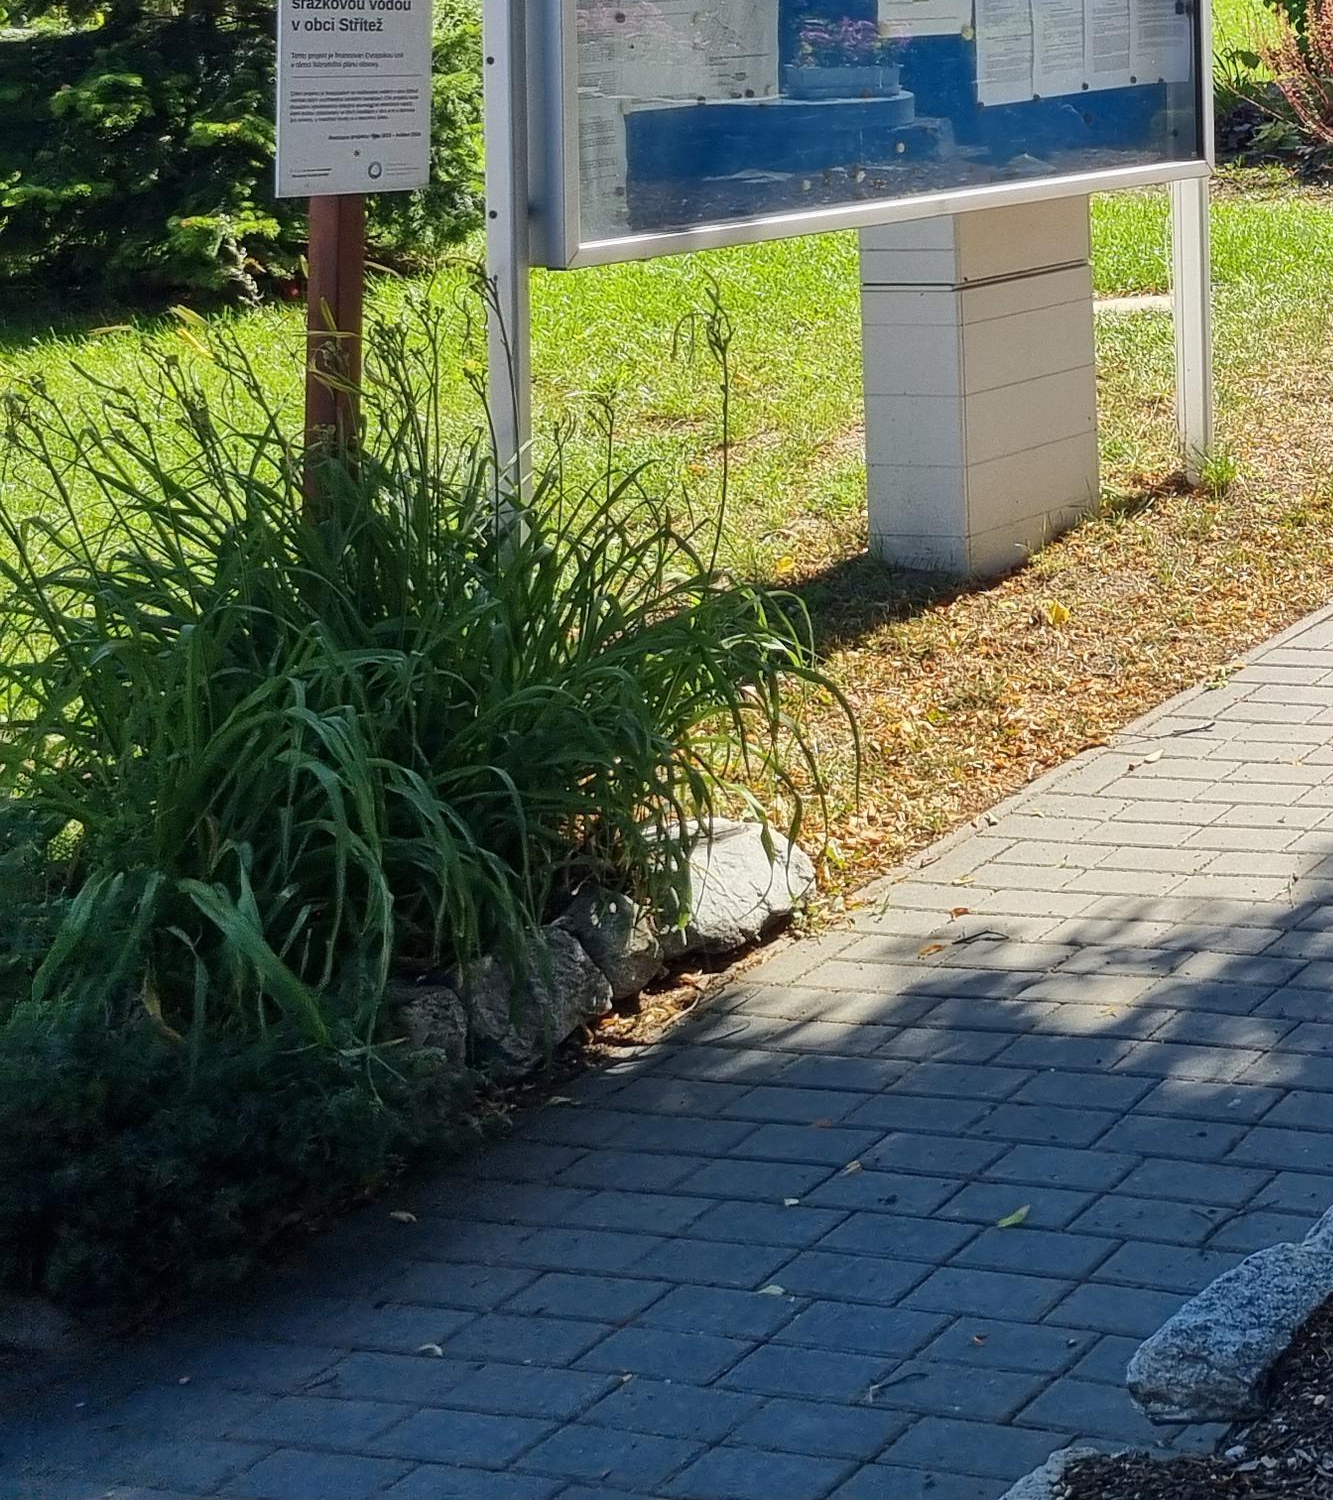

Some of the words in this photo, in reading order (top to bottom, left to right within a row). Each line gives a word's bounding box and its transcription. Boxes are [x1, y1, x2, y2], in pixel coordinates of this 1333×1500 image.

[292, 20, 300, 32] v
[304, 17, 335, 32] obci
[339, 17, 384, 33] Střítež
